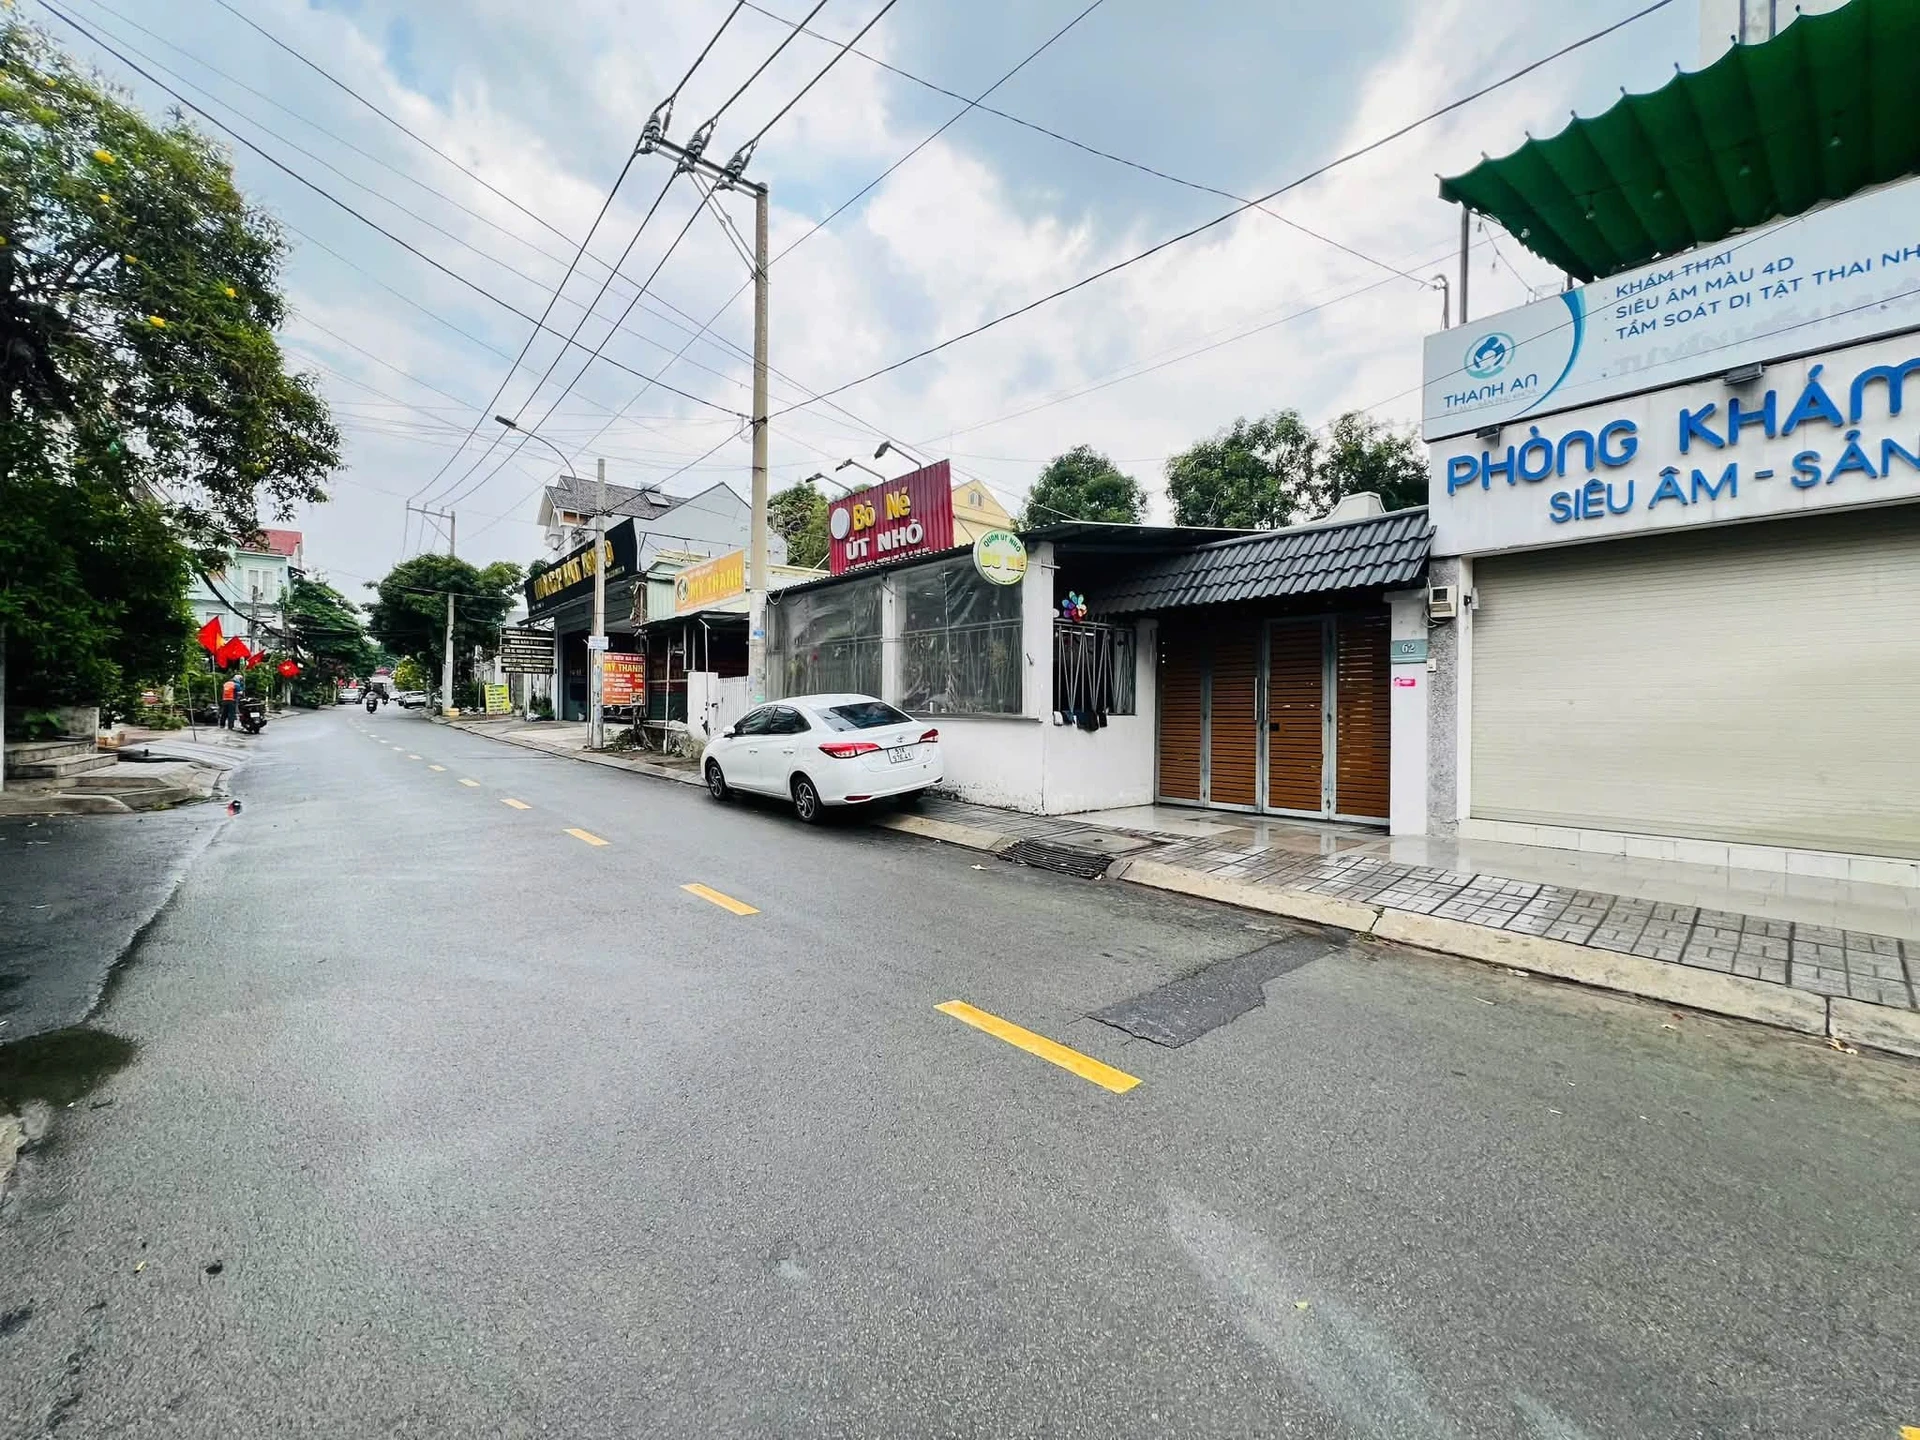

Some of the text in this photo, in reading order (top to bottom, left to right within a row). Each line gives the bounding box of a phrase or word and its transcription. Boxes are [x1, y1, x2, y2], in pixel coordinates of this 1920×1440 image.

[1616, 251, 1733, 298] KHÁM THAI
[1616, 257, 1794, 319] SIÊU ÂM MÀU 4D
[1664, 300, 1720, 327] SOÁT
[1729, 292, 1751, 309] DỊ
[1760, 277, 1804, 300] TẬT
[1812, 258, 1871, 285] THAI
[1549, 478, 1635, 523] SIÊU
[1648, 462, 1739, 510] ÂM
[1790, 429, 1920, 490] SẢN
[1401, 643, 1416, 653] 62
